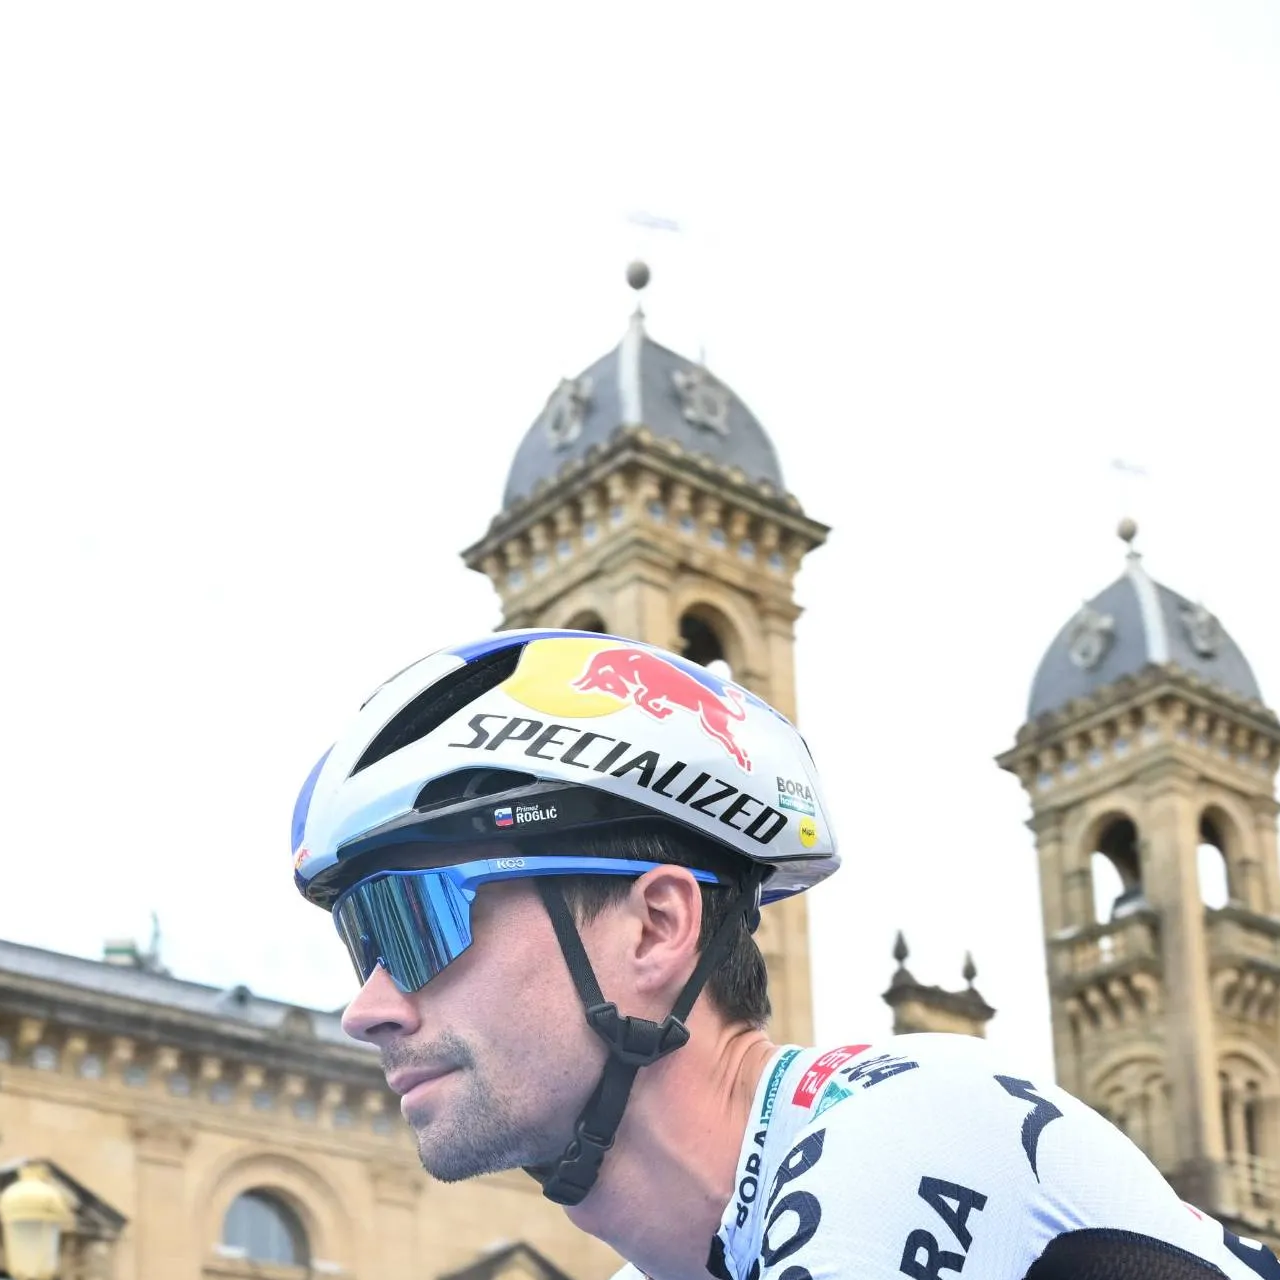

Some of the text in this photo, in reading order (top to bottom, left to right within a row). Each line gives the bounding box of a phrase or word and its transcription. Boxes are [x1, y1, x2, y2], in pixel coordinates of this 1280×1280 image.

[448, 713, 788, 845] SPECIALIZED
[777, 776, 813, 801] BORA
[516, 806, 558, 823] ROGLIČ
